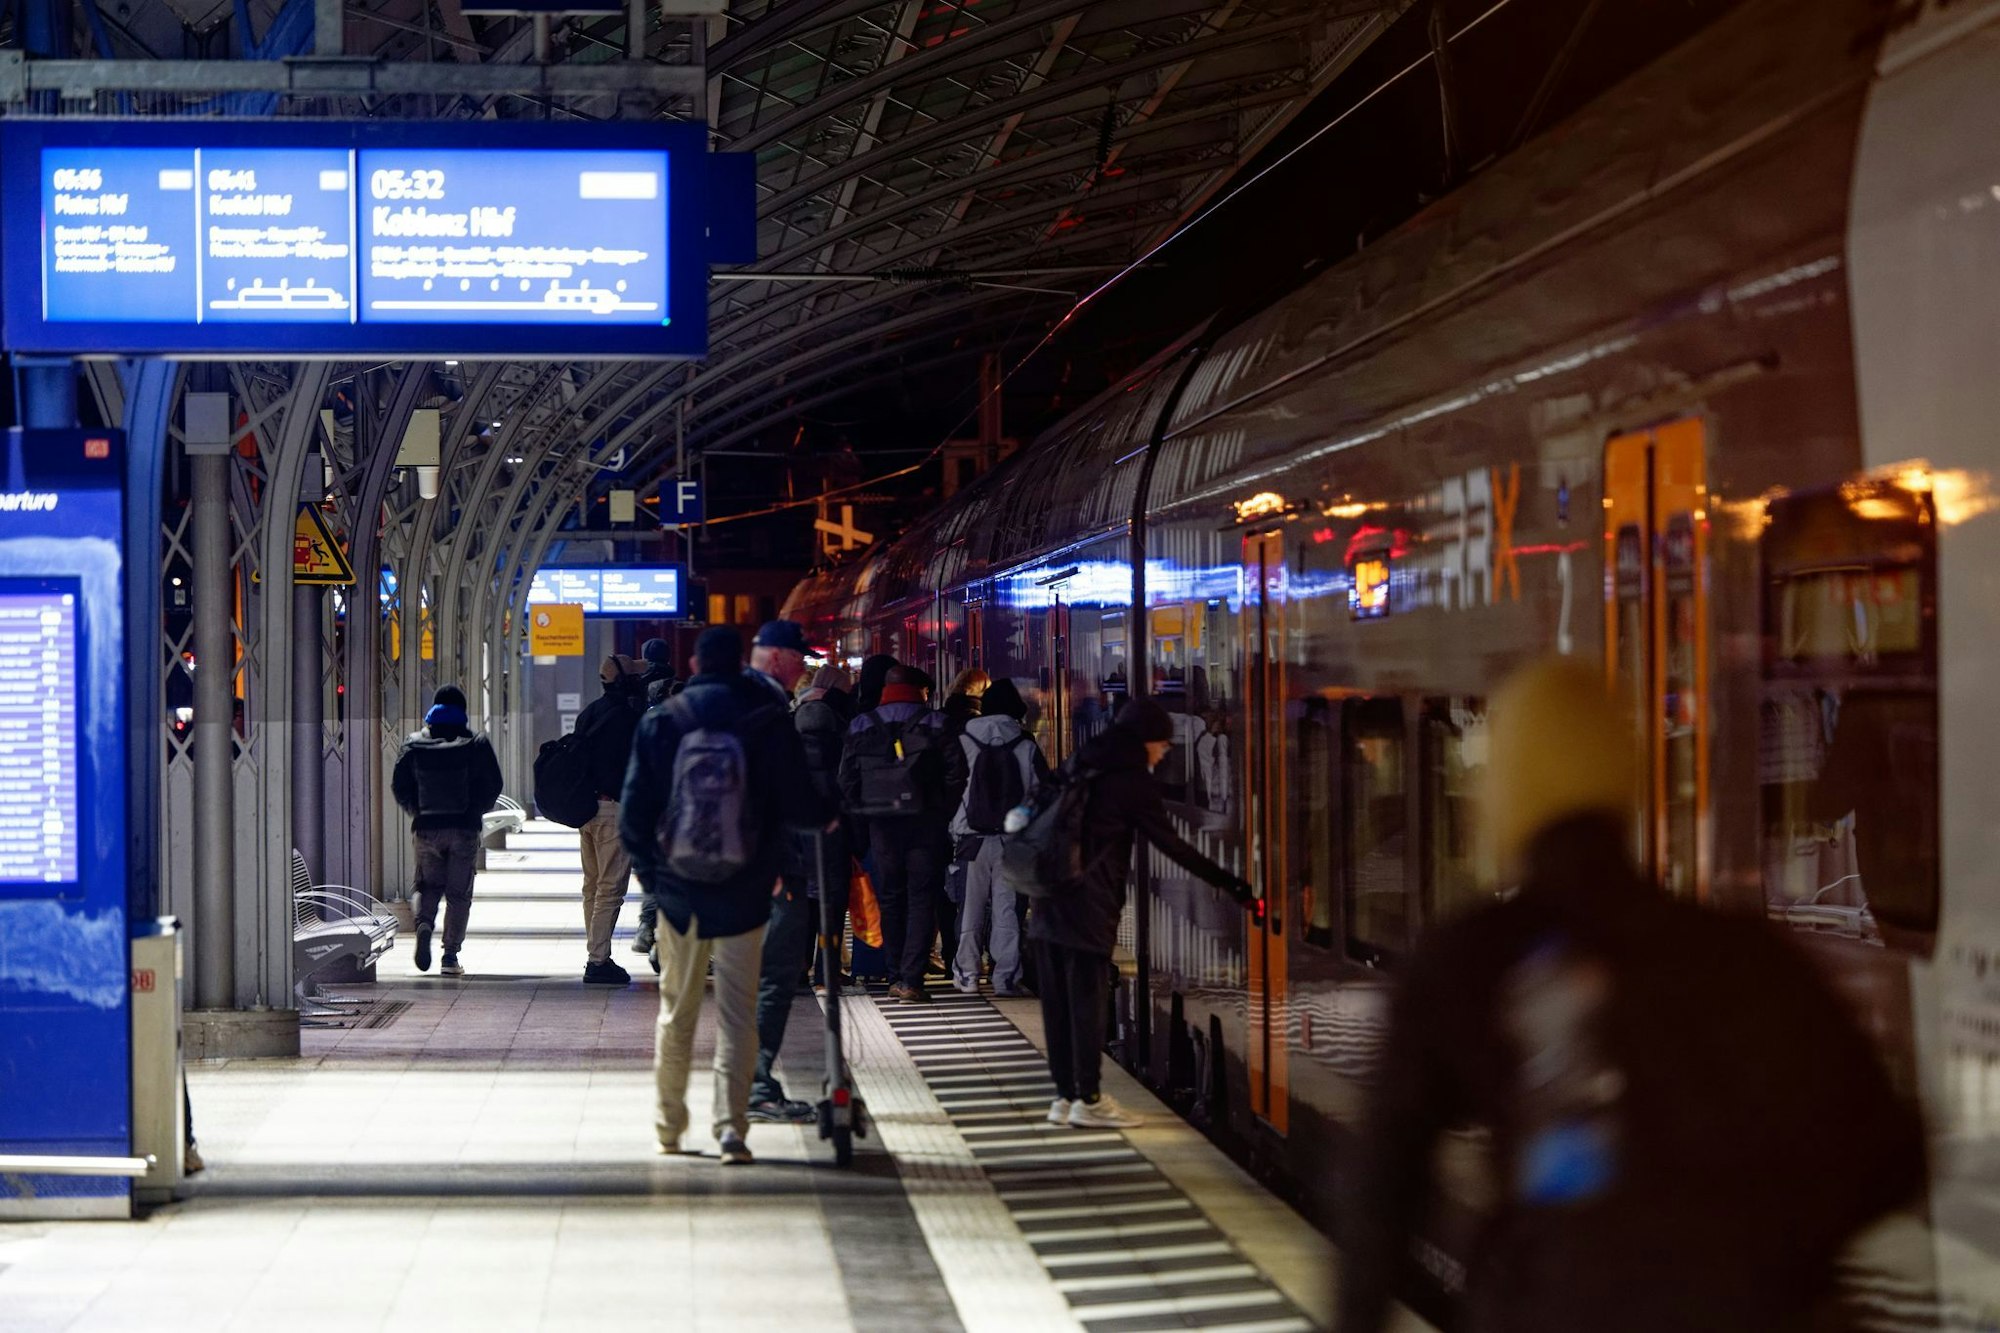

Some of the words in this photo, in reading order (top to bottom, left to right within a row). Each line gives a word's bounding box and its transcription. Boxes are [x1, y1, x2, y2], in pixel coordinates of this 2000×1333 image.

[371, 169, 445, 199] 05:32
[372, 206, 468, 237] Koblenz
[470, 206, 516, 237] Hbf
[677, 482, 697, 514] F
